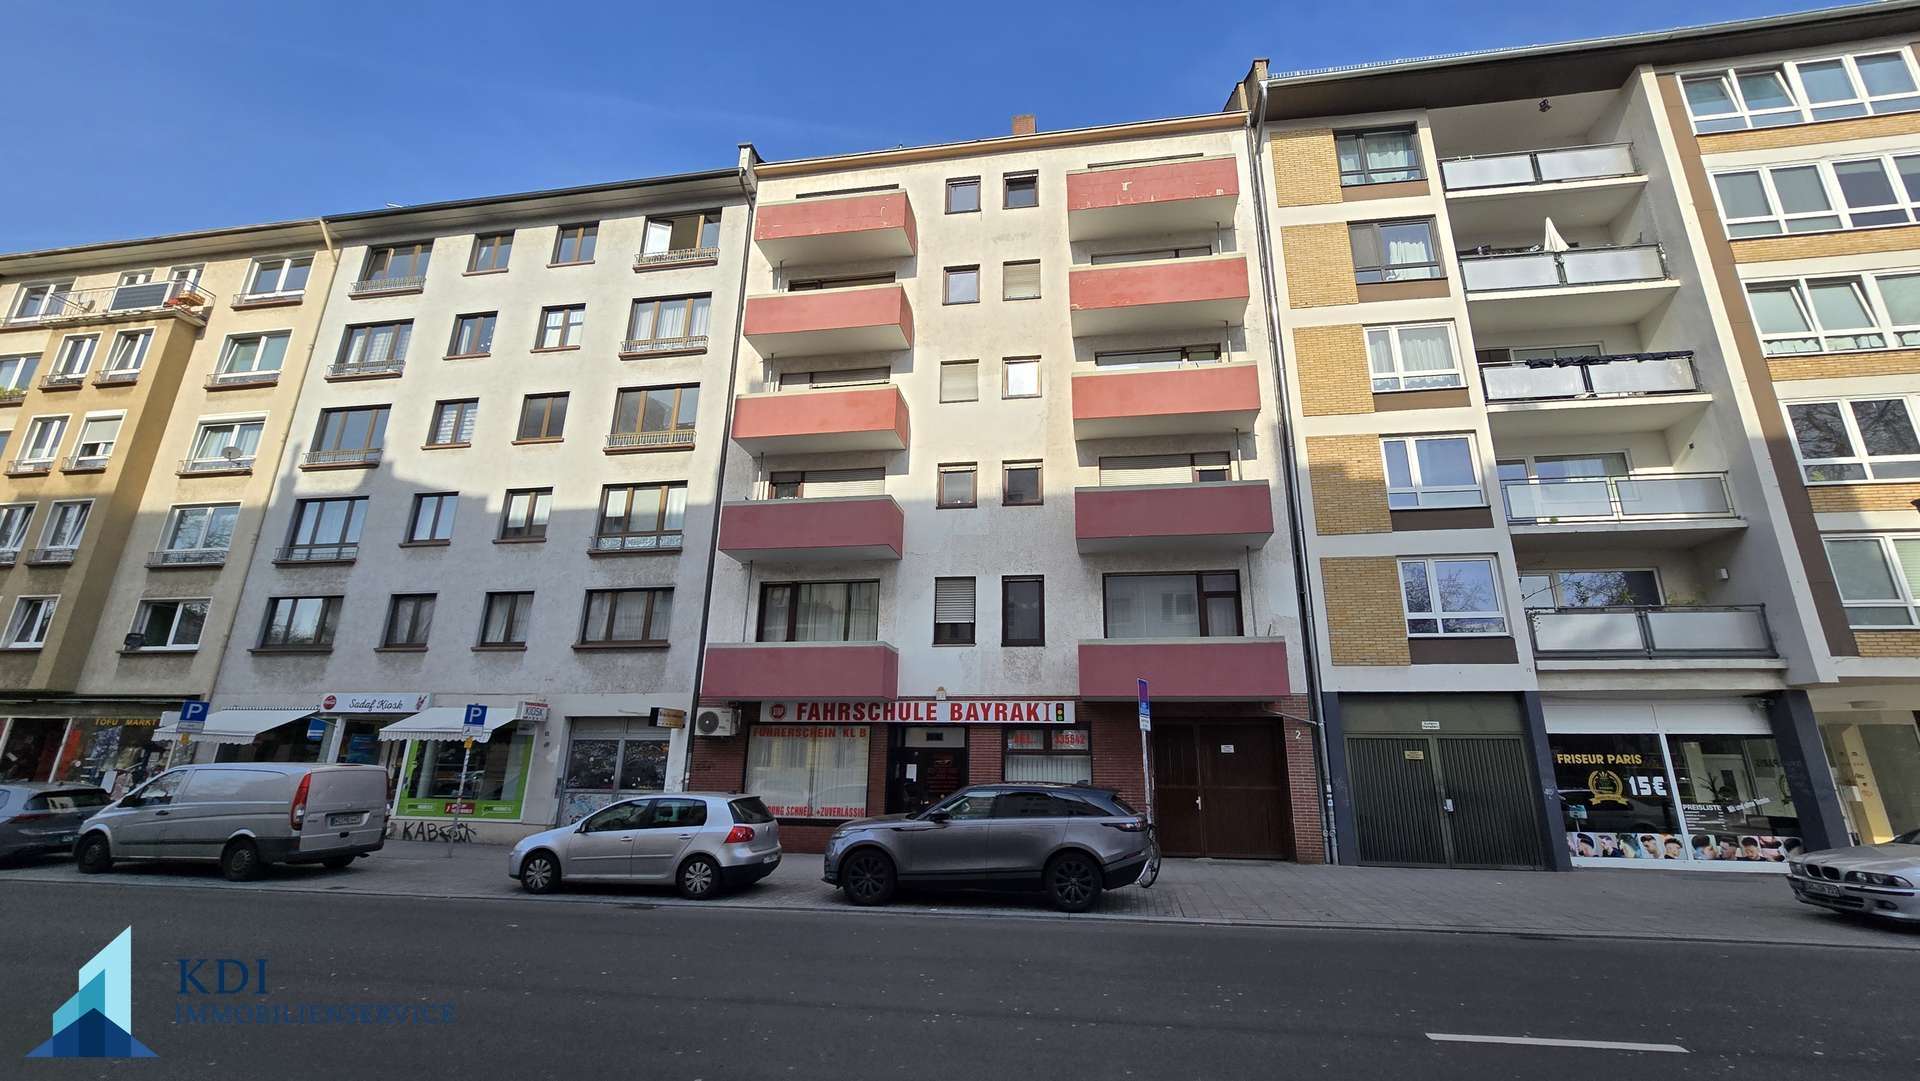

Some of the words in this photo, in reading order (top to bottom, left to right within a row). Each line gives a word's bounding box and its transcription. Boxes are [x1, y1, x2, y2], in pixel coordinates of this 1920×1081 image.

[186, 703, 204, 719] P
[349, 698, 376, 711] Sadaf
[377, 699, 403, 710] Kiosk
[469, 707, 482, 722] P
[797, 703, 937, 720] FAHRSCHULE
[95, 719, 119, 727] TOFU
[125, 719, 156, 727] MARKT
[859, 727, 867, 737] B
[1295, 730, 1301, 740] 2
[1557, 754, 1604, 764] FRISEUR
[1607, 754, 1642, 764] PARIS
[1628, 775, 1667, 796] 15€
